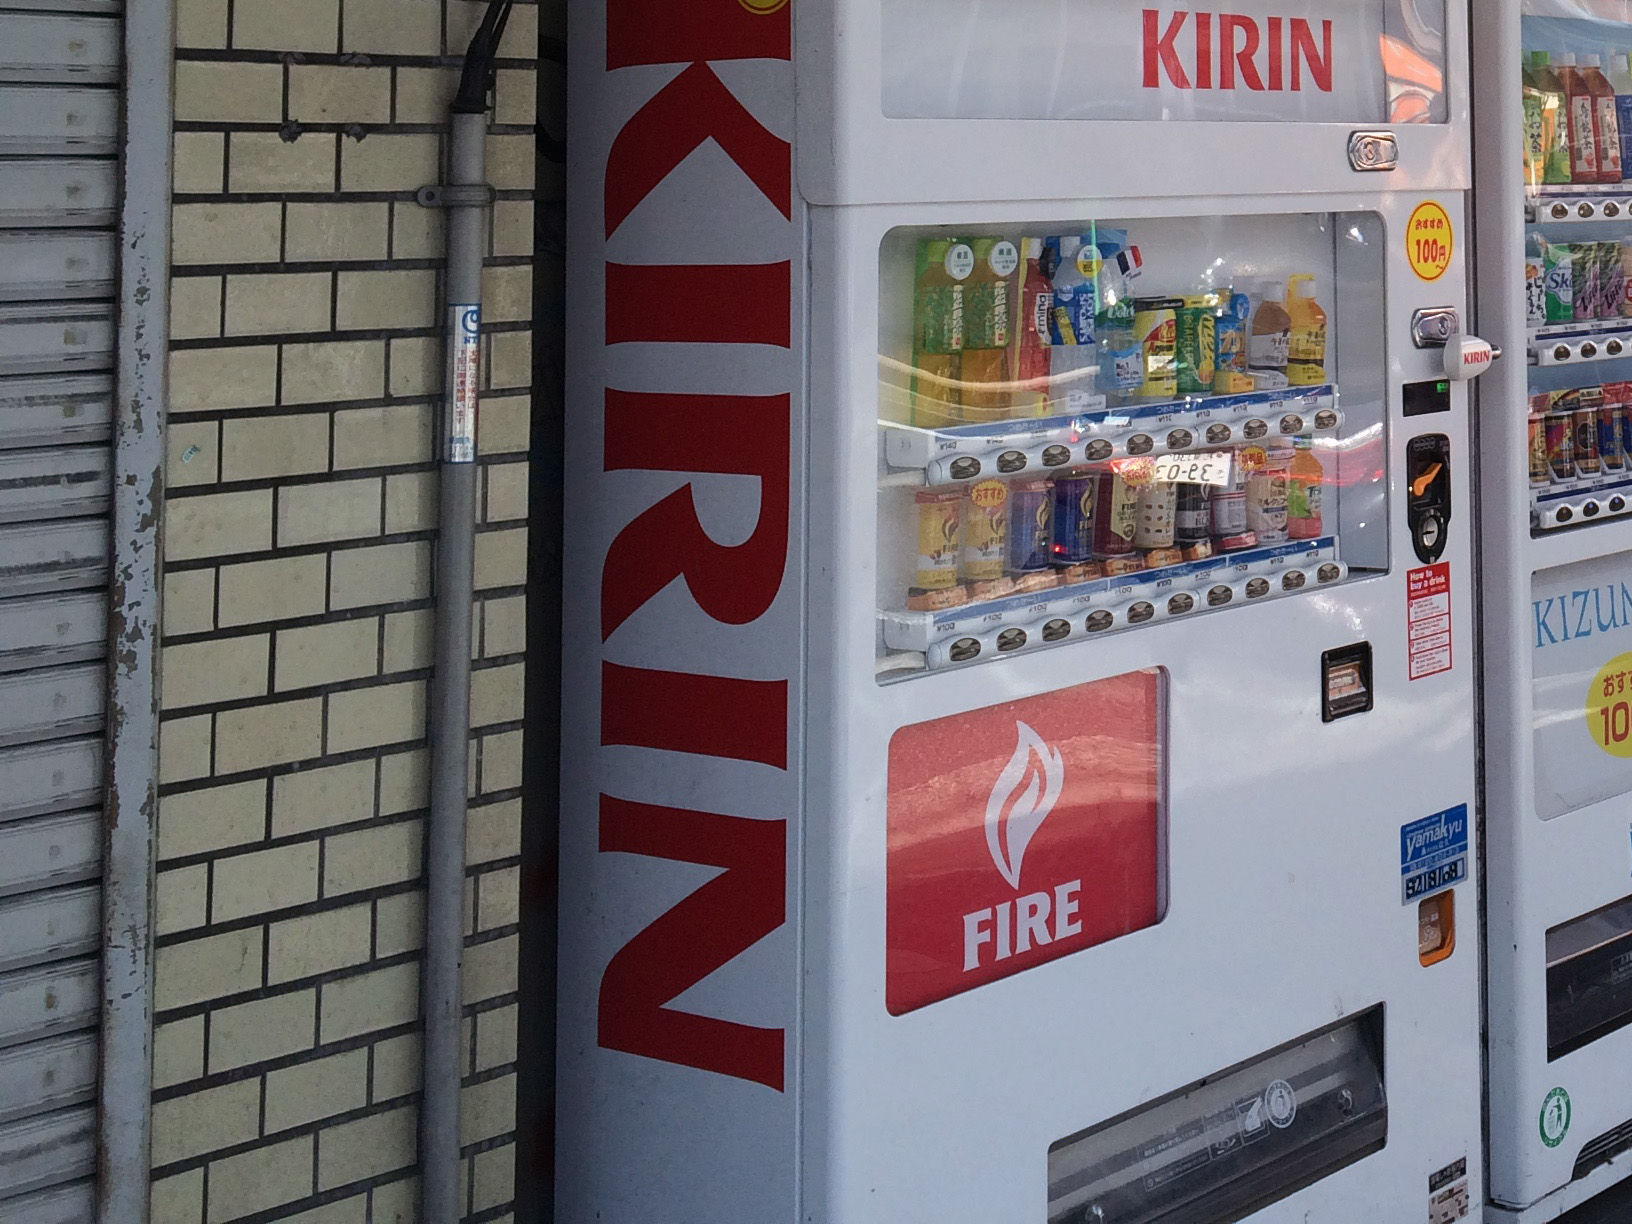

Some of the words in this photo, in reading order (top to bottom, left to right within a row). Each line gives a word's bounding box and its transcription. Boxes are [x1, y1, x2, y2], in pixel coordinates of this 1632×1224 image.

[1142, 9, 1333, 93] KIRIN
[1415, 219, 1446, 231] おすすめ
[1463, 348, 1491, 366] KIRIN
[1410, 572, 1425, 582] How
[1429, 575, 1446, 586] drink
[1407, 814, 1464, 862] yamakyu
[963, 879, 1083, 973] FIRE
